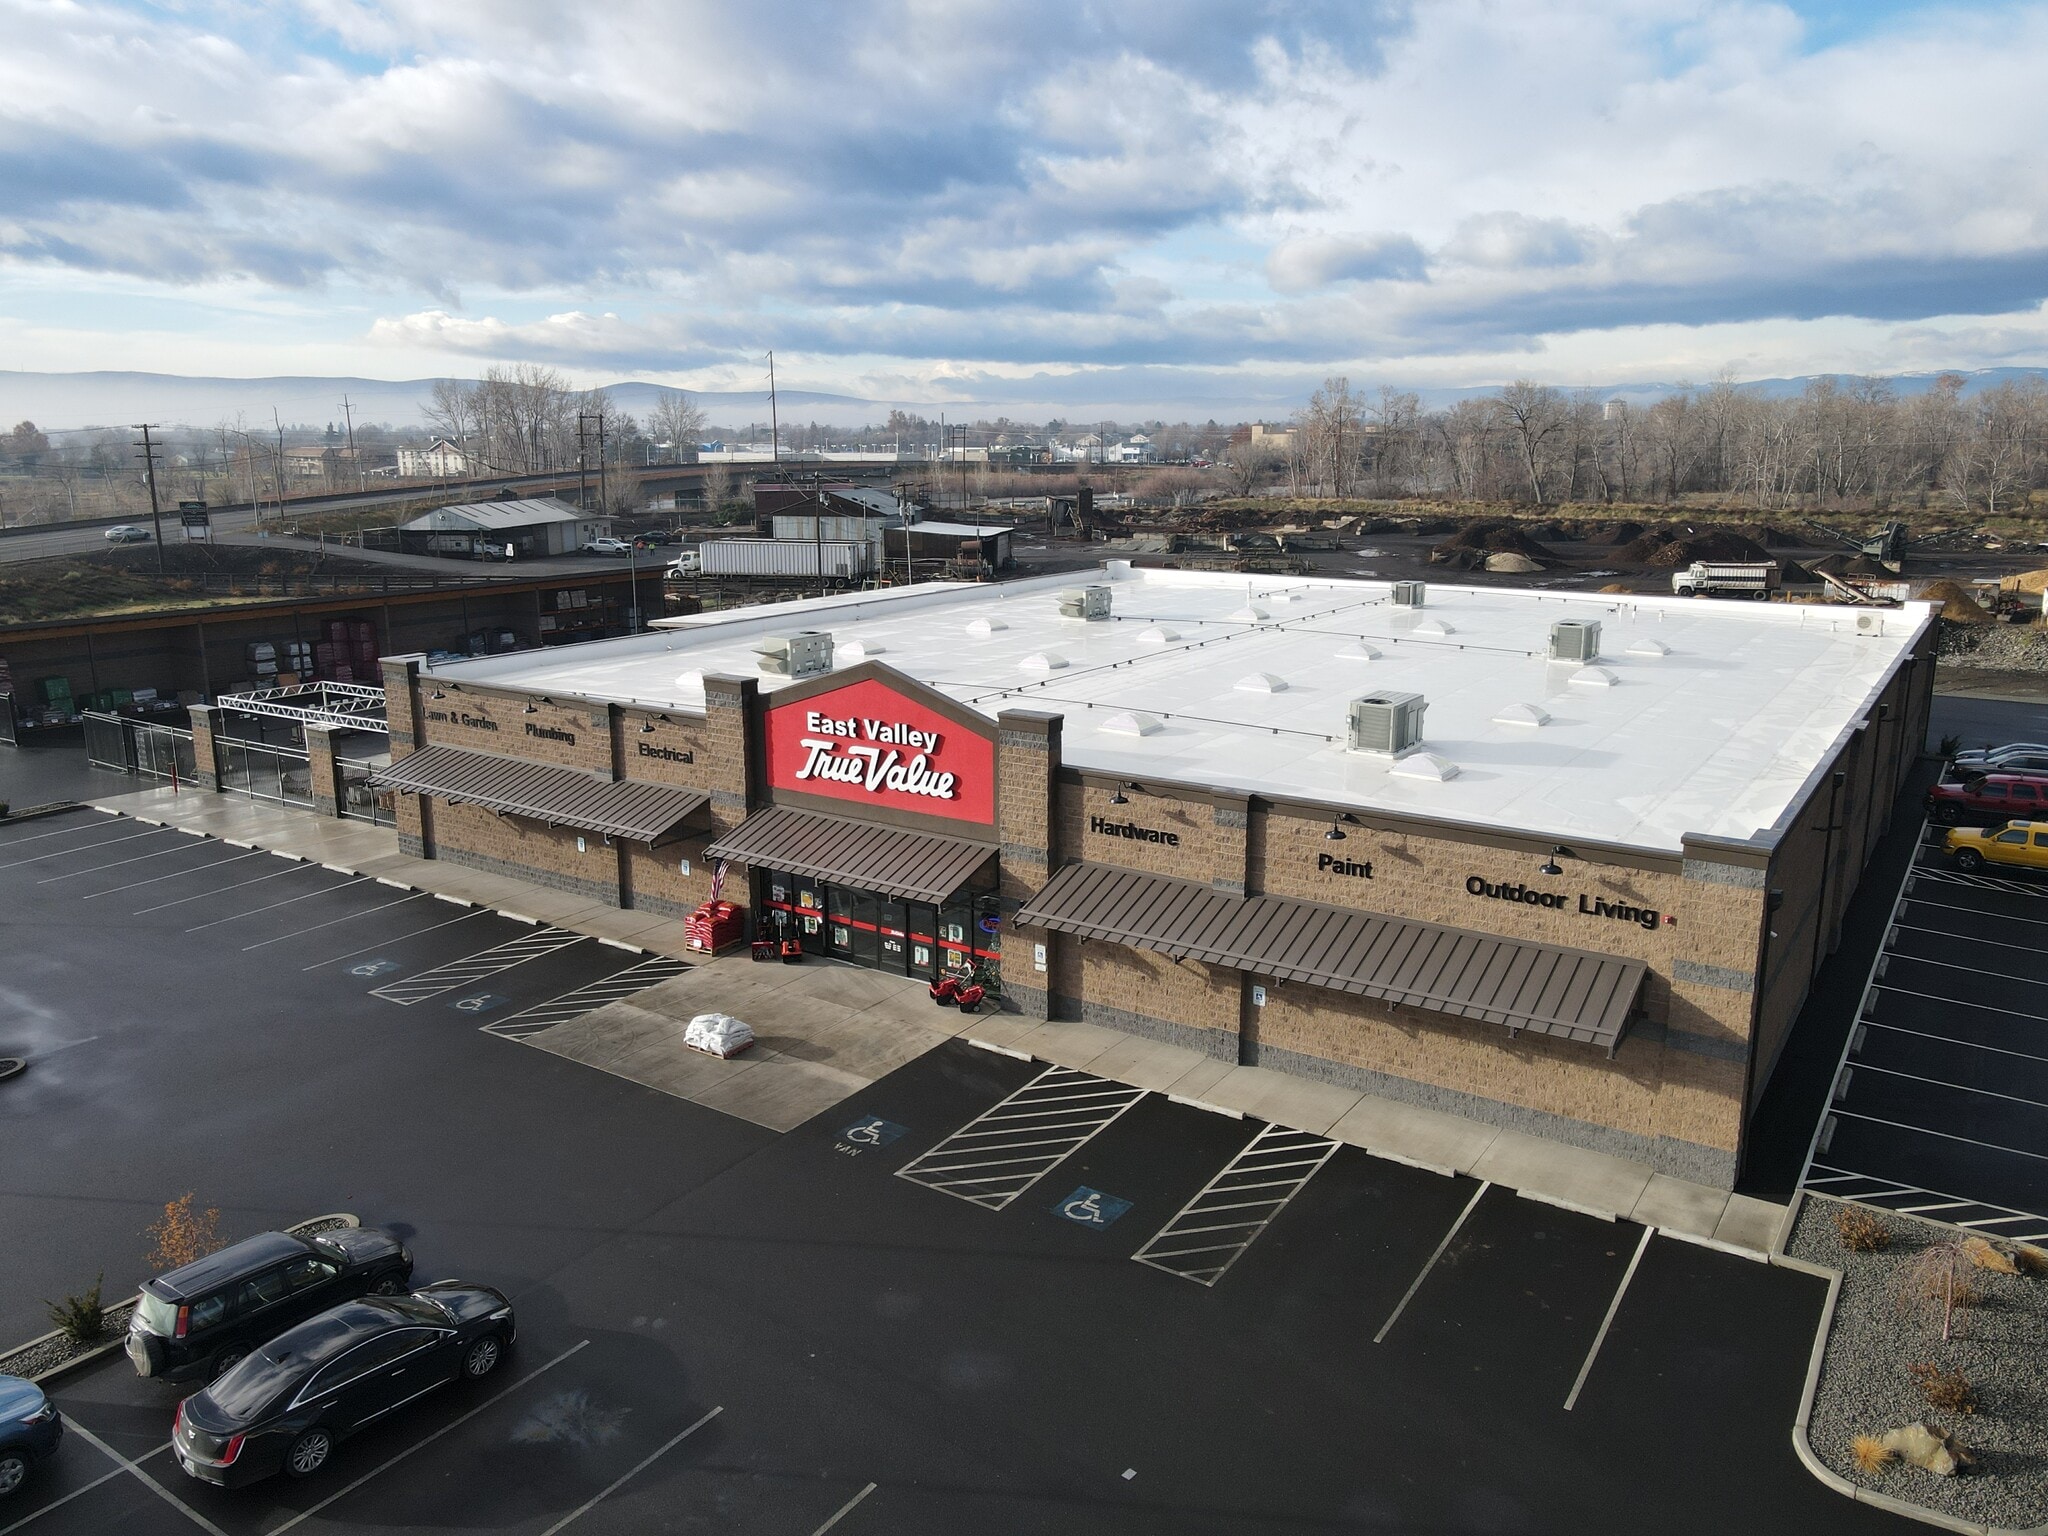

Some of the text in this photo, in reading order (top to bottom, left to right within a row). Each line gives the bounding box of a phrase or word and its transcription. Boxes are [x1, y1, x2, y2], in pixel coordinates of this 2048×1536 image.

[423, 706, 498, 731] Lawn & Garden
[806, 711, 938, 754] East Valley
[525, 722, 576, 747] Plumbing
[638, 741, 694, 765] Electrical
[795, 738, 955, 799] True Value
[1090, 815, 1180, 846] Hardware
[1318, 852, 1374, 880] Paint
[1466, 875, 1660, 930] Outdoor Living
